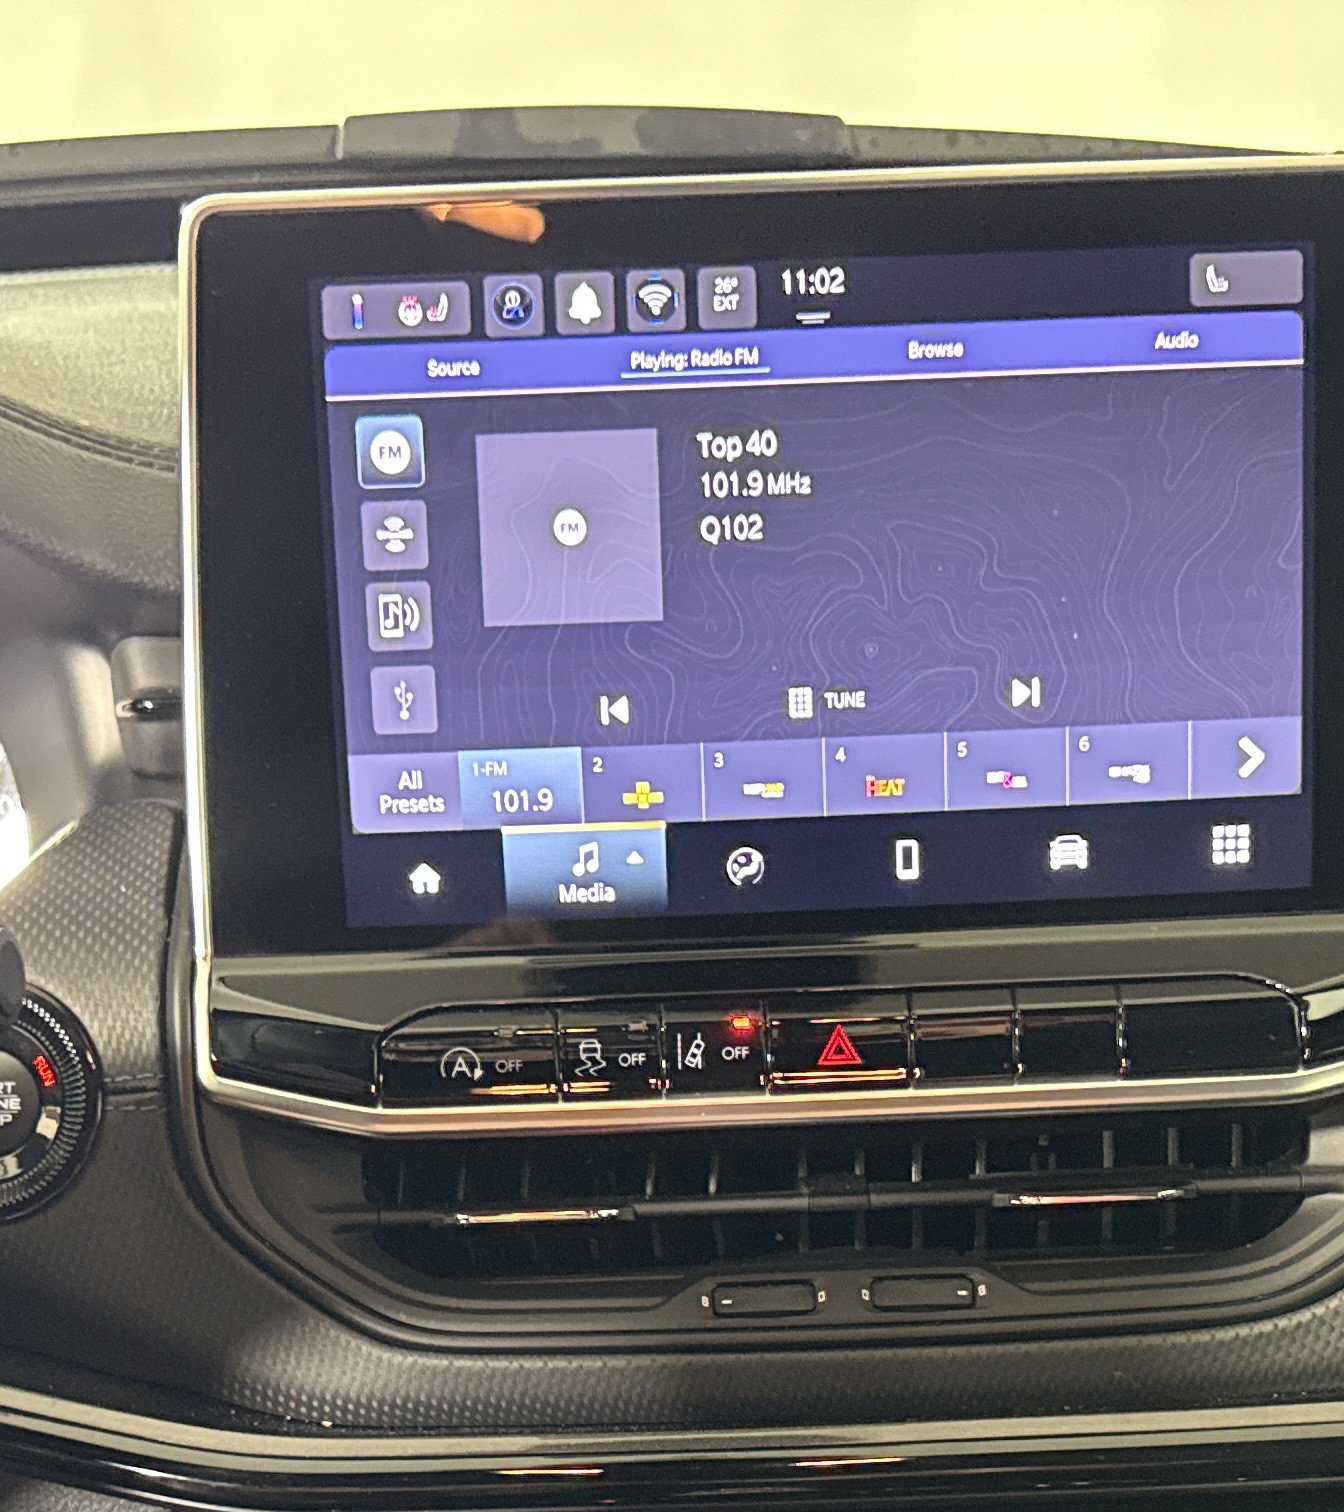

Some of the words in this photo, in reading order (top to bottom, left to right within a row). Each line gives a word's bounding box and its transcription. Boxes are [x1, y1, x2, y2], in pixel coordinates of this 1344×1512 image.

[781, 266, 846, 295] 11:02
[713, 293, 739, 312] EXT
[908, 339, 964, 360] Browse
[1154, 330, 1200, 350] Audio
[427, 358, 481, 379] Source
[630, 349, 688, 372] Playing:
[690, 347, 733, 367] Radio
[734, 346, 759, 366] FM
[378, 445, 402, 460] FM
[696, 431, 743, 461] Top
[744, 429, 778, 457] 40
[700, 469, 763, 498] 101.9
[766, 471, 812, 496] MHz
[560, 522, 579, 534] FM
[699, 512, 764, 544] Q102
[823, 690, 866, 709] TUNE
[835, 746, 847, 763] 4
[956, 741, 968, 758] 5
[1078, 736, 1090, 754] 6
[472, 760, 508, 777] 1-FM
[592, 756, 604, 773] 2
[713, 752, 725, 769] 3
[397, 769, 423, 790] All
[865, 777, 906, 798] HEAT
[379, 794, 445, 816] Presets
[491, 788, 554, 814] 101.9
[558, 883, 616, 904] Media
[618, 1053, 647, 1069] OFF
[721, 1045, 751, 1062] OFF
[32, 1053, 57, 1089] RUN
[494, 1058, 524, 1074] OFF
